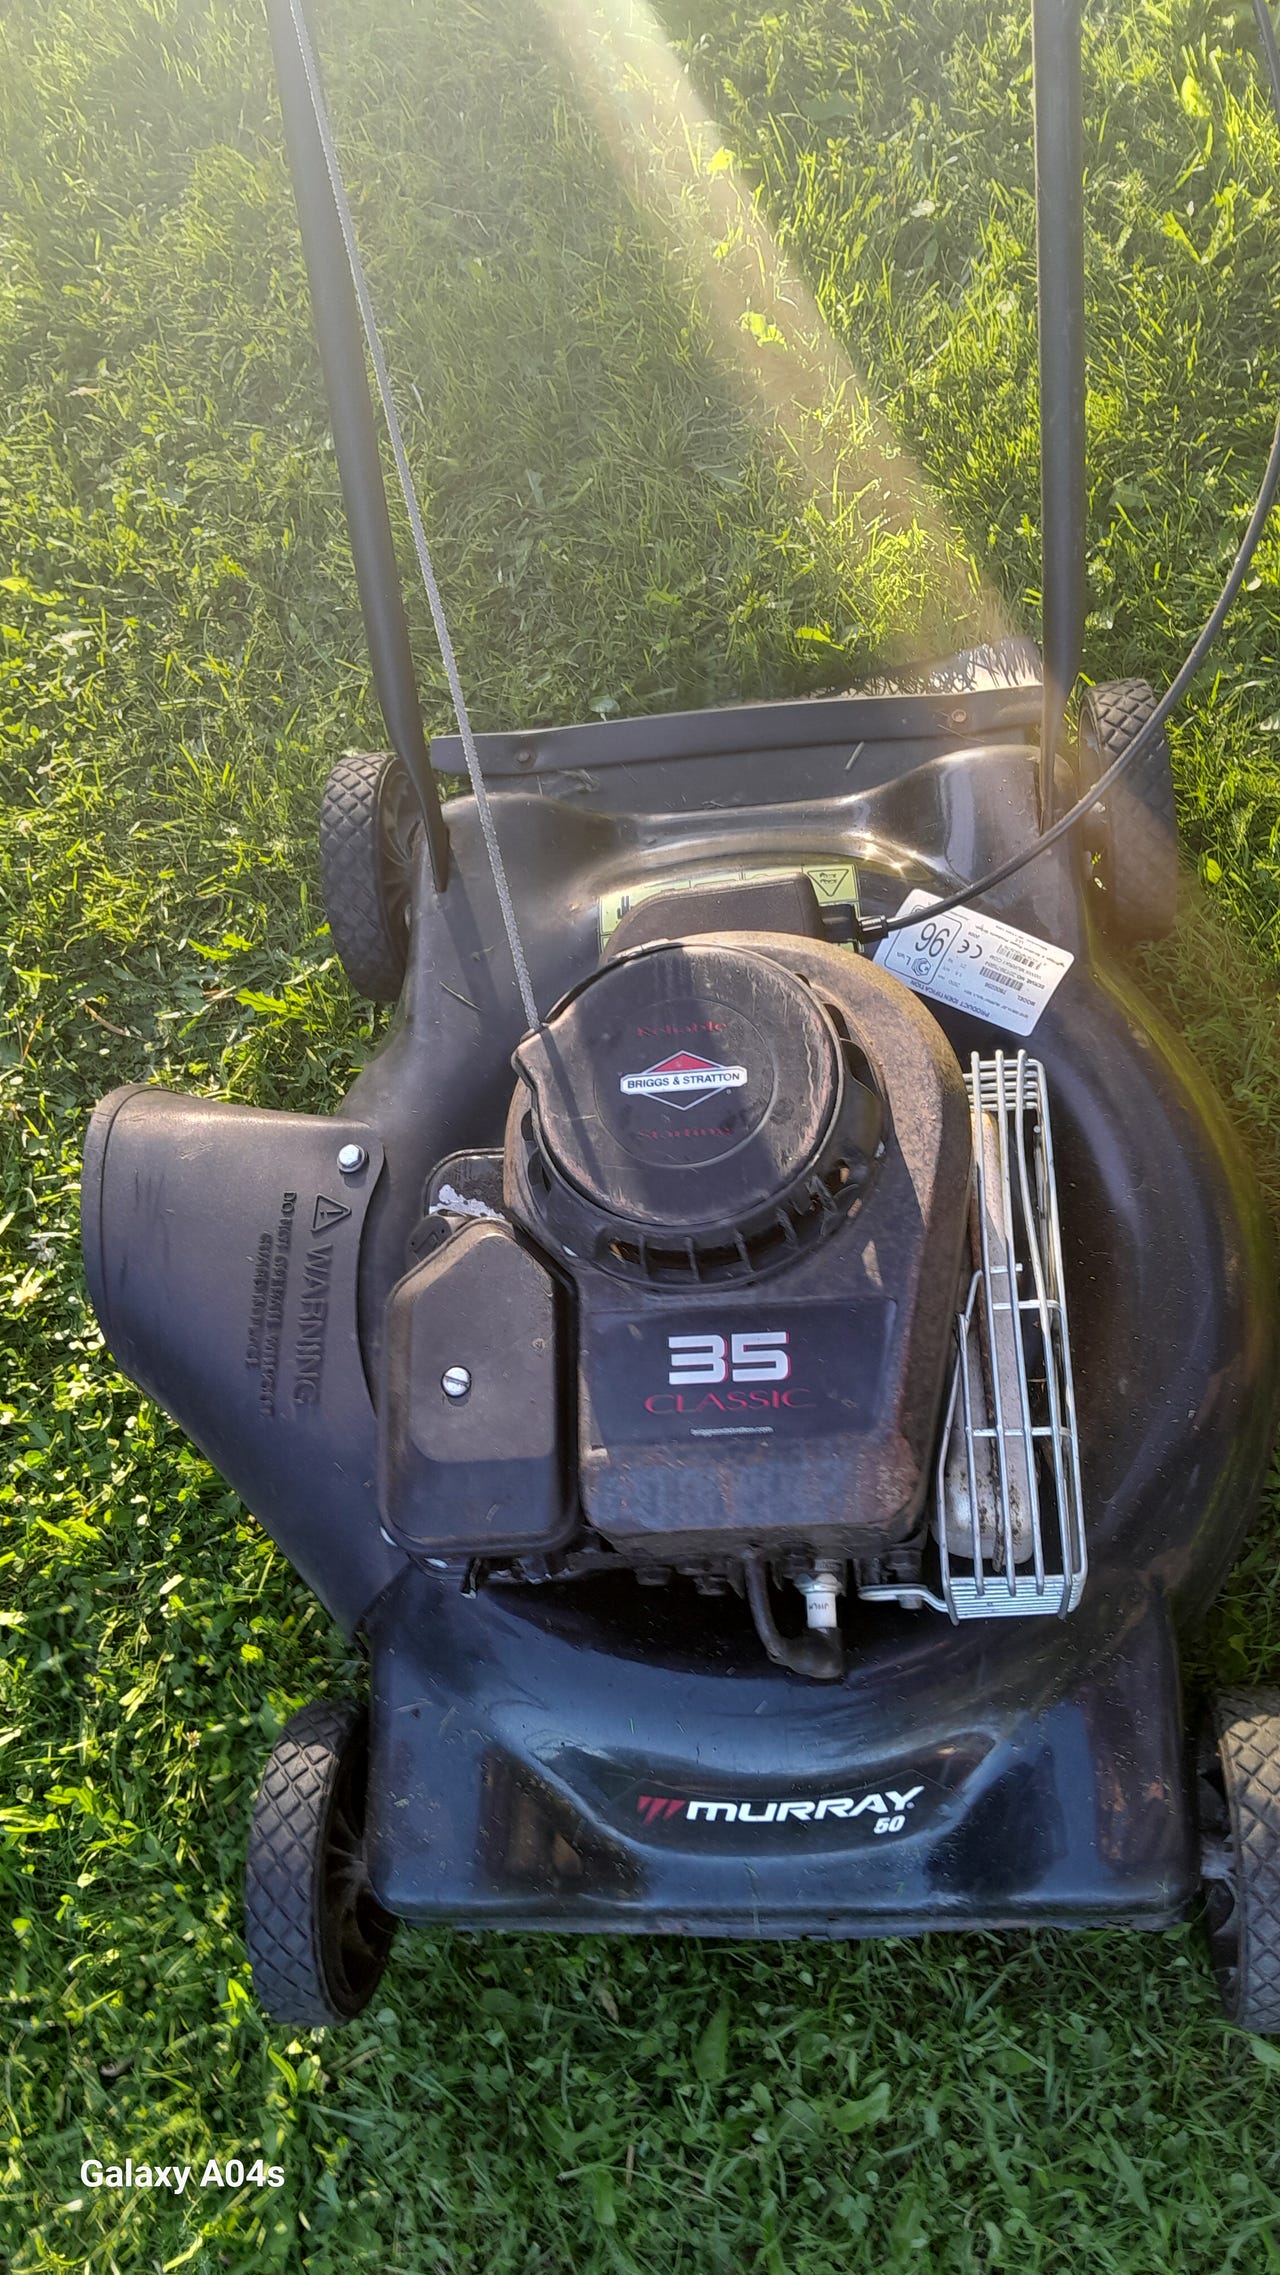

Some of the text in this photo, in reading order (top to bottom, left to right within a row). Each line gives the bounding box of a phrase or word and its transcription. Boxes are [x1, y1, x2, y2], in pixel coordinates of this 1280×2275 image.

[915, 922, 950, 957] 96
[957, 939, 982, 959] CE
[909, 978, 958, 1004] IDENTIFICATION
[959, 1000, 990, 1017] PRODUCT
[627, 1072, 740, 1089] BRIGGS & STRATTON
[294, 1243, 333, 1404] WARNING
[668, 1331, 792, 1385] 35
[643, 1387, 817, 1414] CLASSIC
[685, 1785, 925, 1822] MURRAY
[873, 1815, 906, 1834] 50
